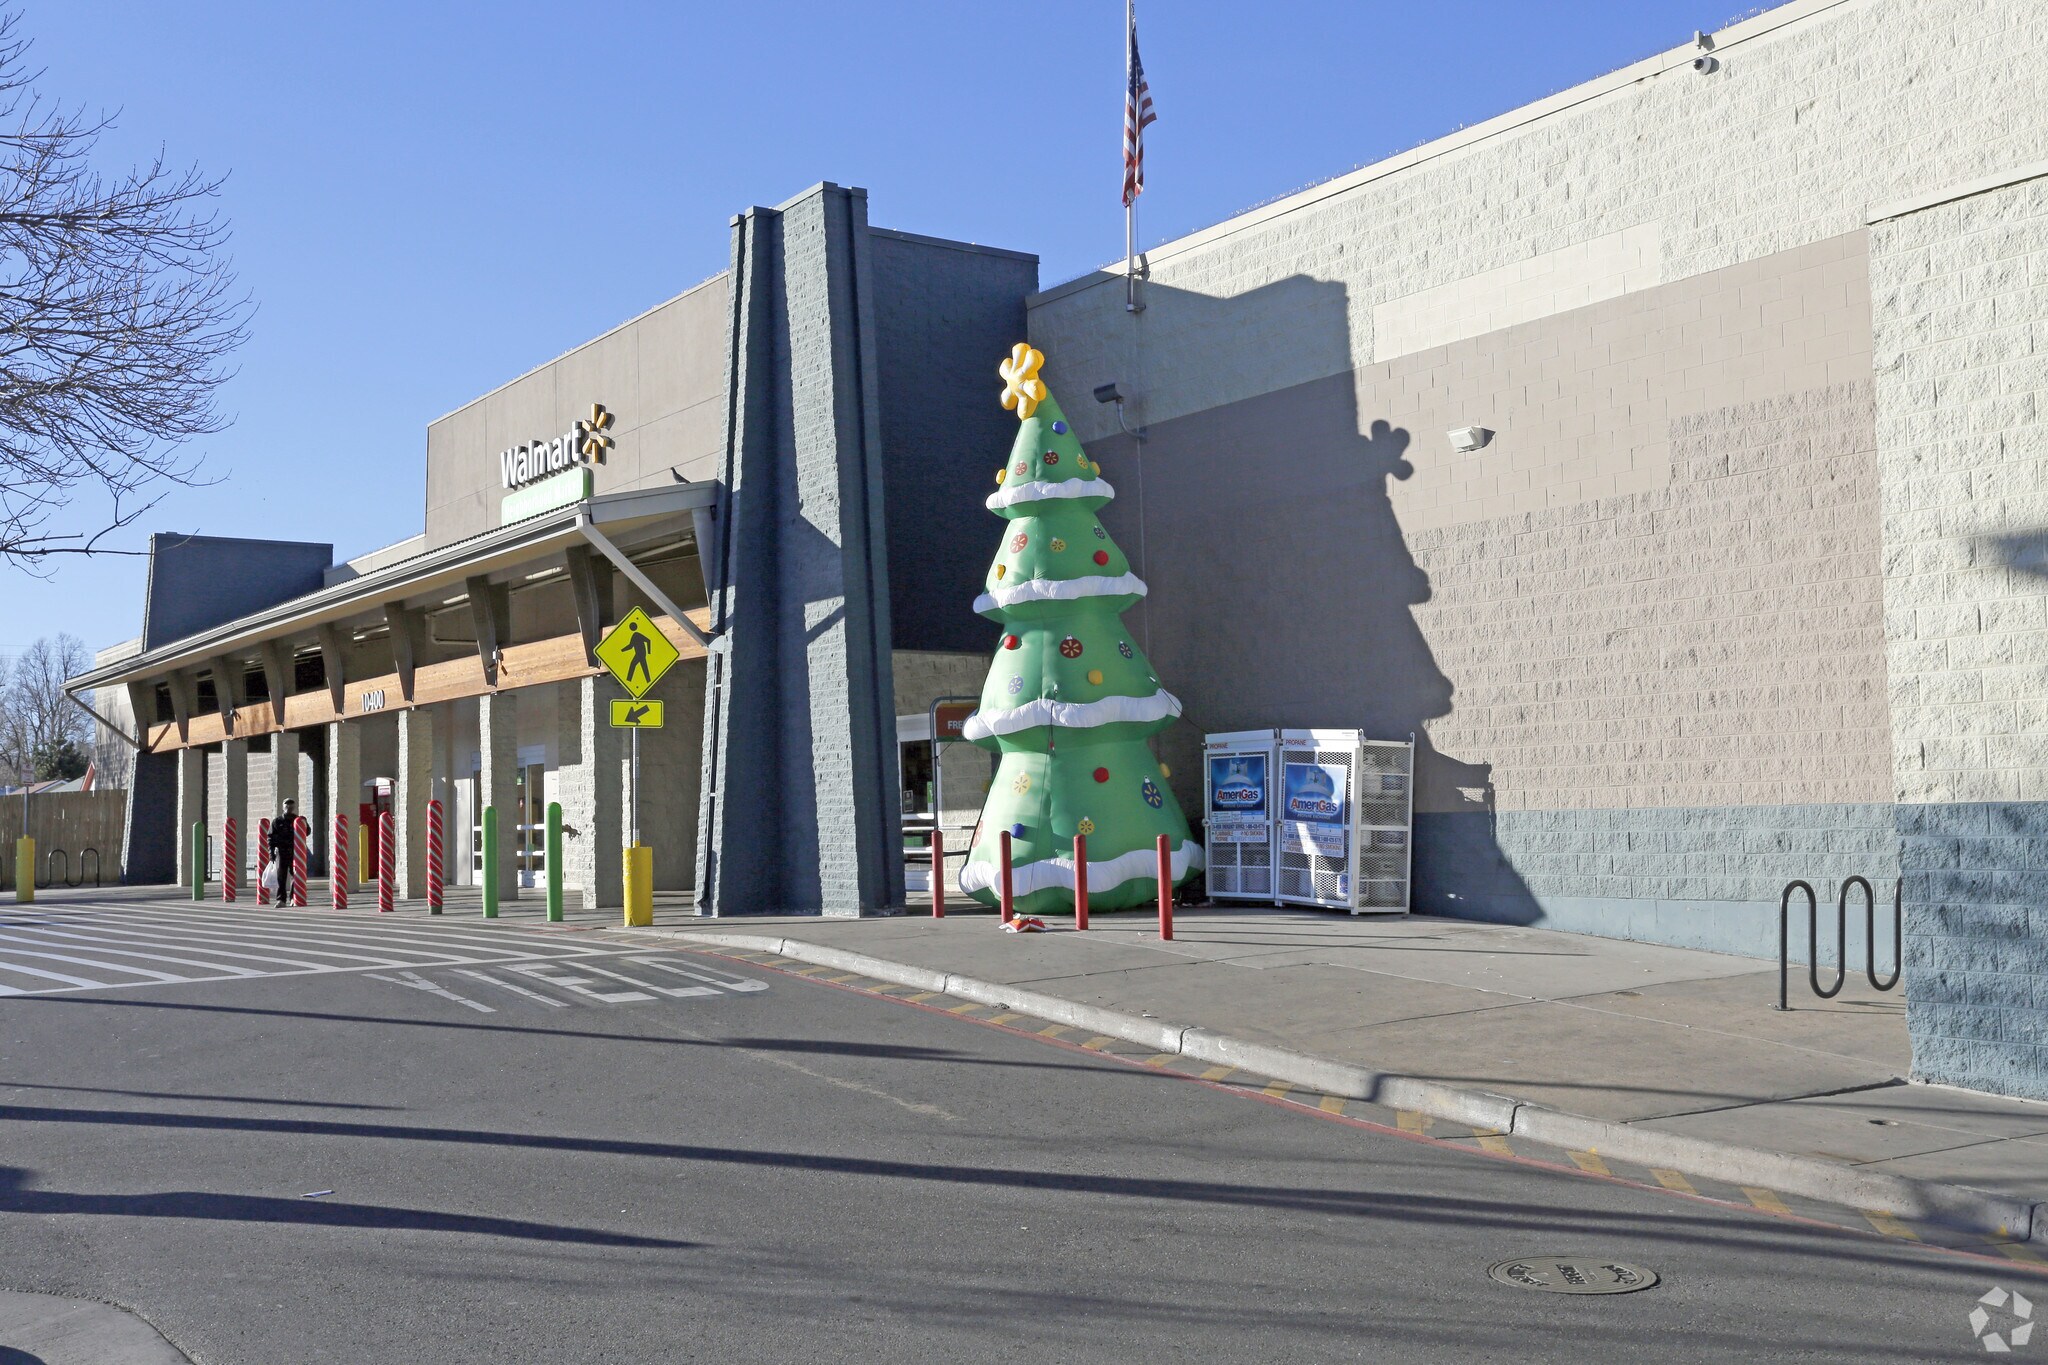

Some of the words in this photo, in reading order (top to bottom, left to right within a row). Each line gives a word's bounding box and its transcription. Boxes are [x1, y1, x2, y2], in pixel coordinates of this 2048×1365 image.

[501, 421, 581, 489] Walmart
[361, 690, 384, 712] 10400
[1217, 789, 1258, 801] AmeriGas
[1291, 798, 1338, 812] AmeriGas
[362, 956, 770, 1013] YIELD
